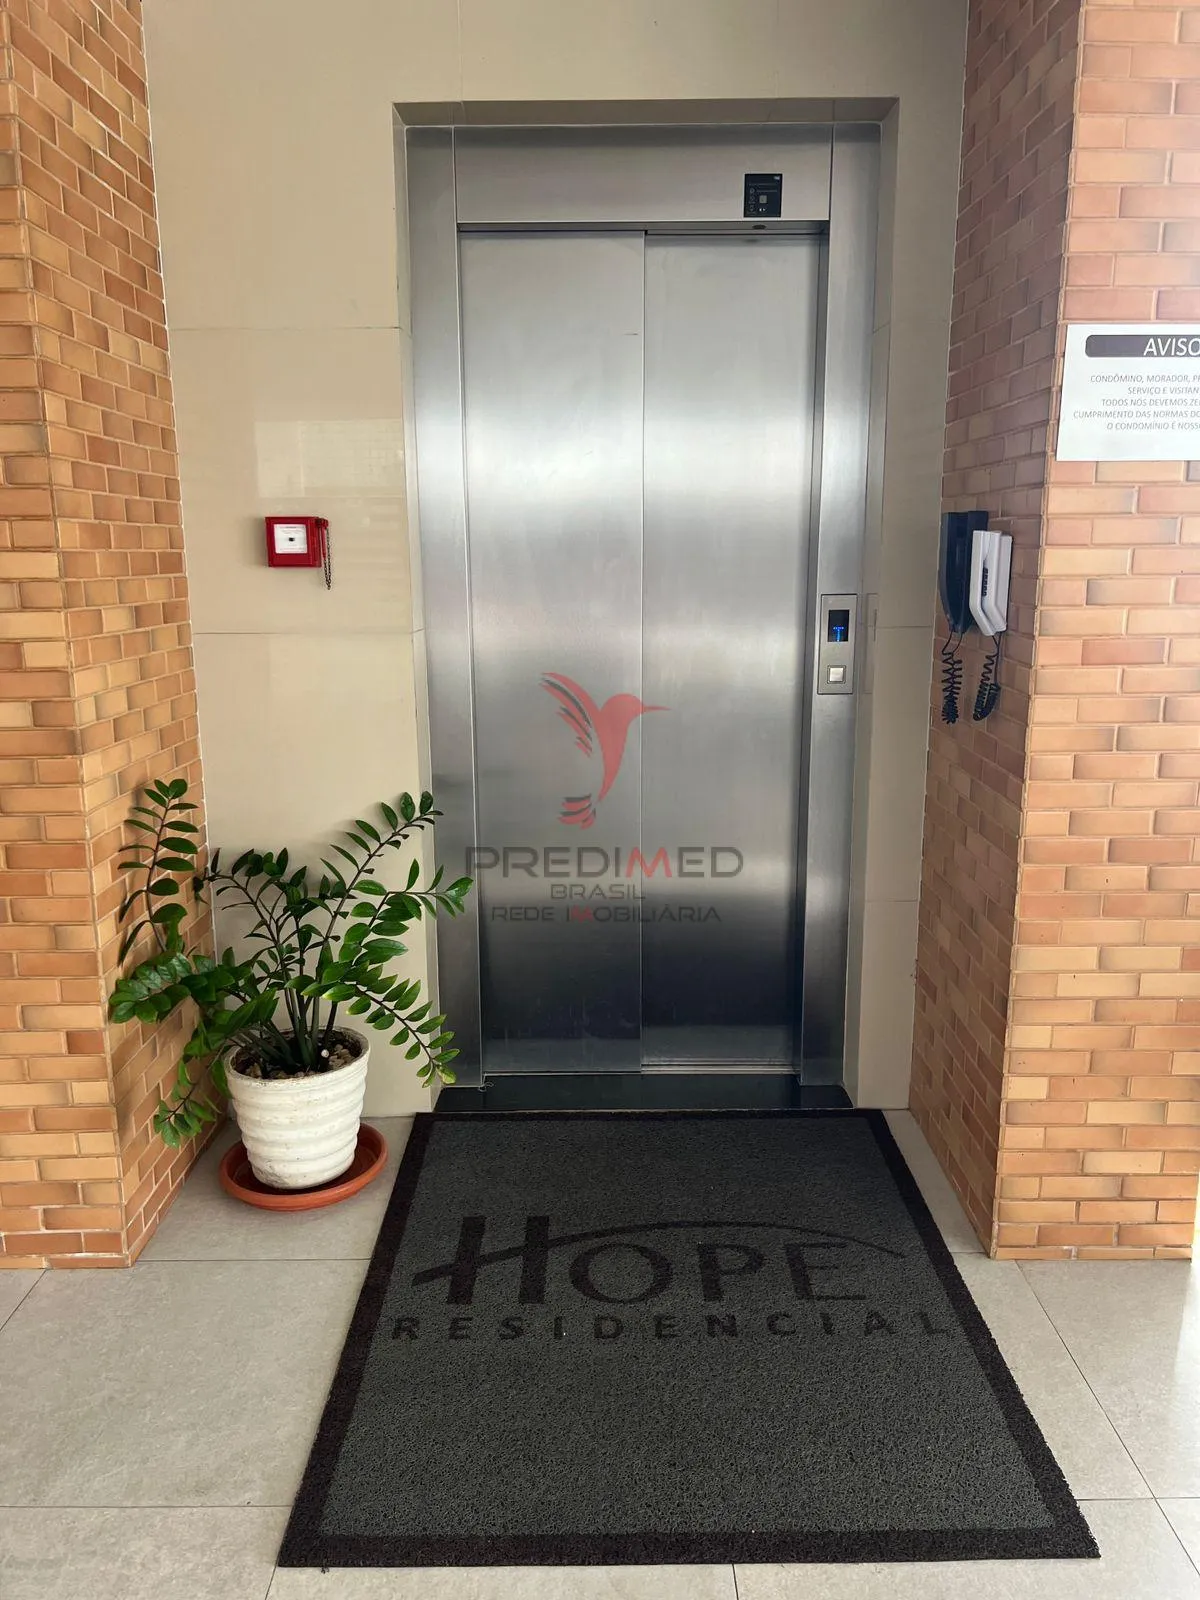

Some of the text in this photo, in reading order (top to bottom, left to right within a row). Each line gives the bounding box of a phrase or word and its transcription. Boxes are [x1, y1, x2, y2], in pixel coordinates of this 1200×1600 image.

[1143, 337, 1200, 356] AVISO
[1090, 373, 1144, 384] CONDÔMINO,
[1128, 386, 1161, 396] SERVIÇO
[1163, 387, 1168, 395] E
[1102, 398, 1128, 407] TODOS
[1149, 398, 1188, 407] DEVEMOS
[1073, 410, 1134, 419] CUMPRIMENTO
[1136, 410, 1151, 418] DAS
[1153, 410, 1189, 418] NORMAS
[1107, 422, 1113, 430] O
[1178, 422, 1200, 431] NOSS
[412, 1215, 867, 1305] HOPE
[391, 1310, 953, 1341] RESIDENCIAL
